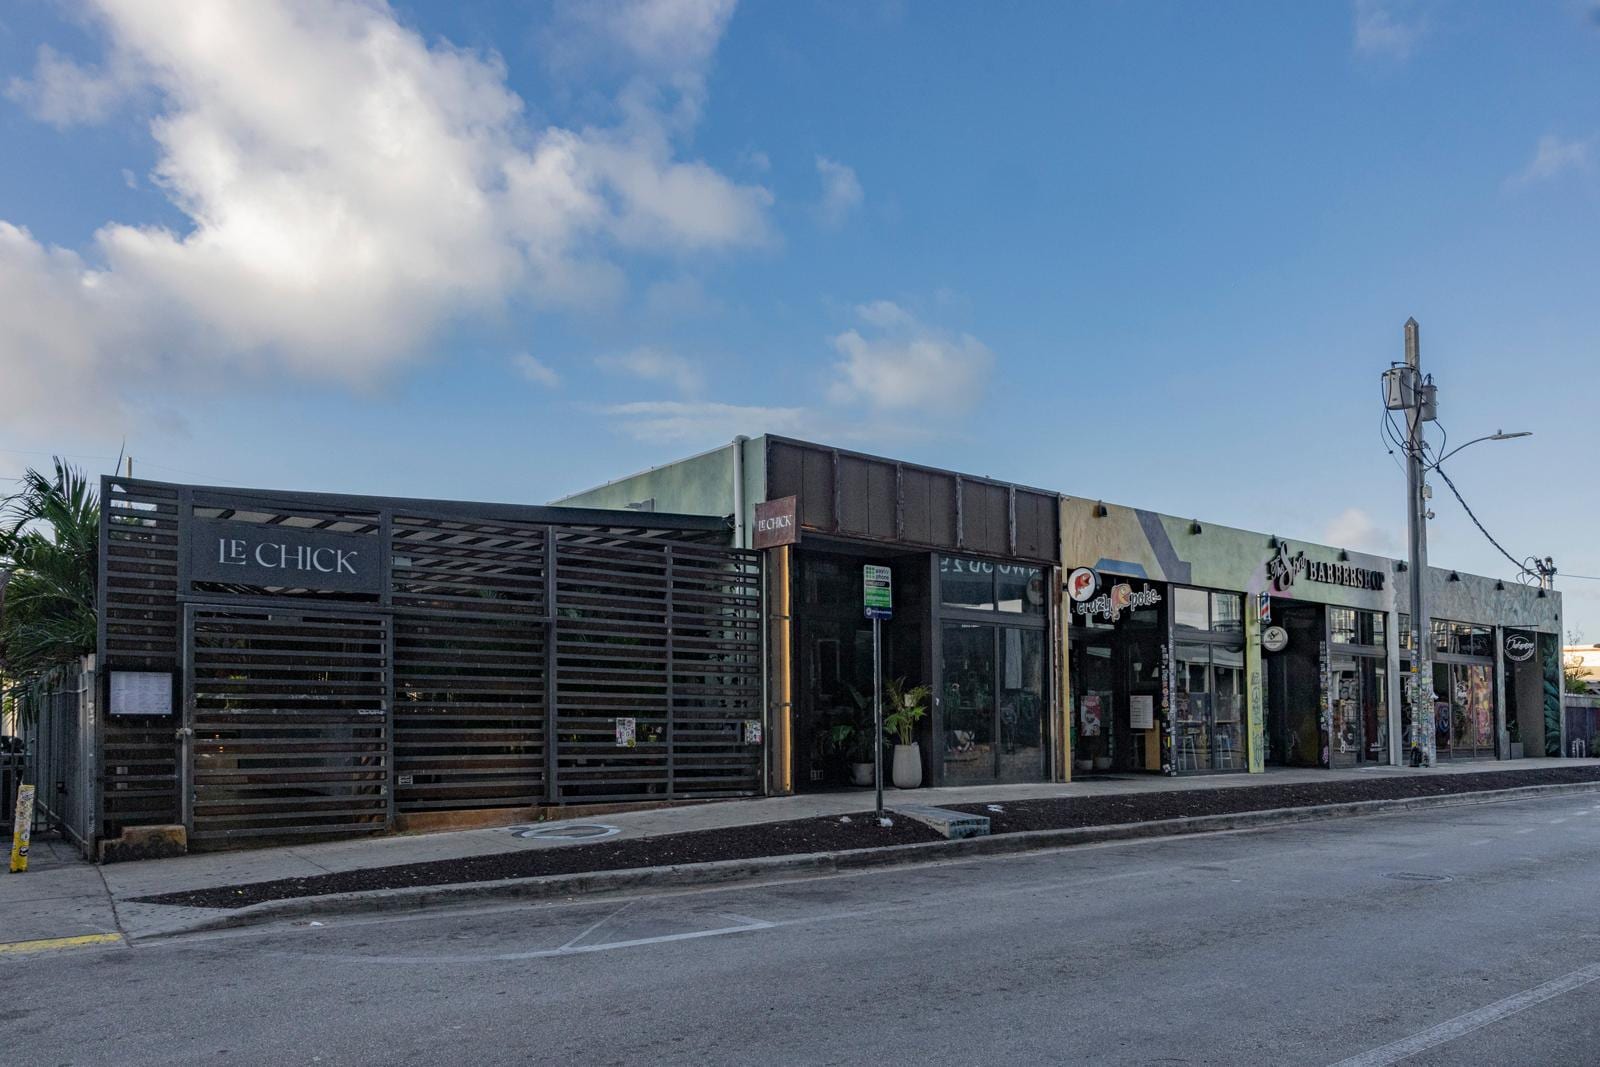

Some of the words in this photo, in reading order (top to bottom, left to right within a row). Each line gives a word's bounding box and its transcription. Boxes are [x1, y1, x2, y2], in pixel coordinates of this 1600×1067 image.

[766, 514, 793, 530] CHICK
[218, 538, 247, 565] LE
[255, 542, 358, 575] CHICK
[1307, 559, 1386, 591] BARBERSHOP
[1130, 582, 1162, 612] poke
